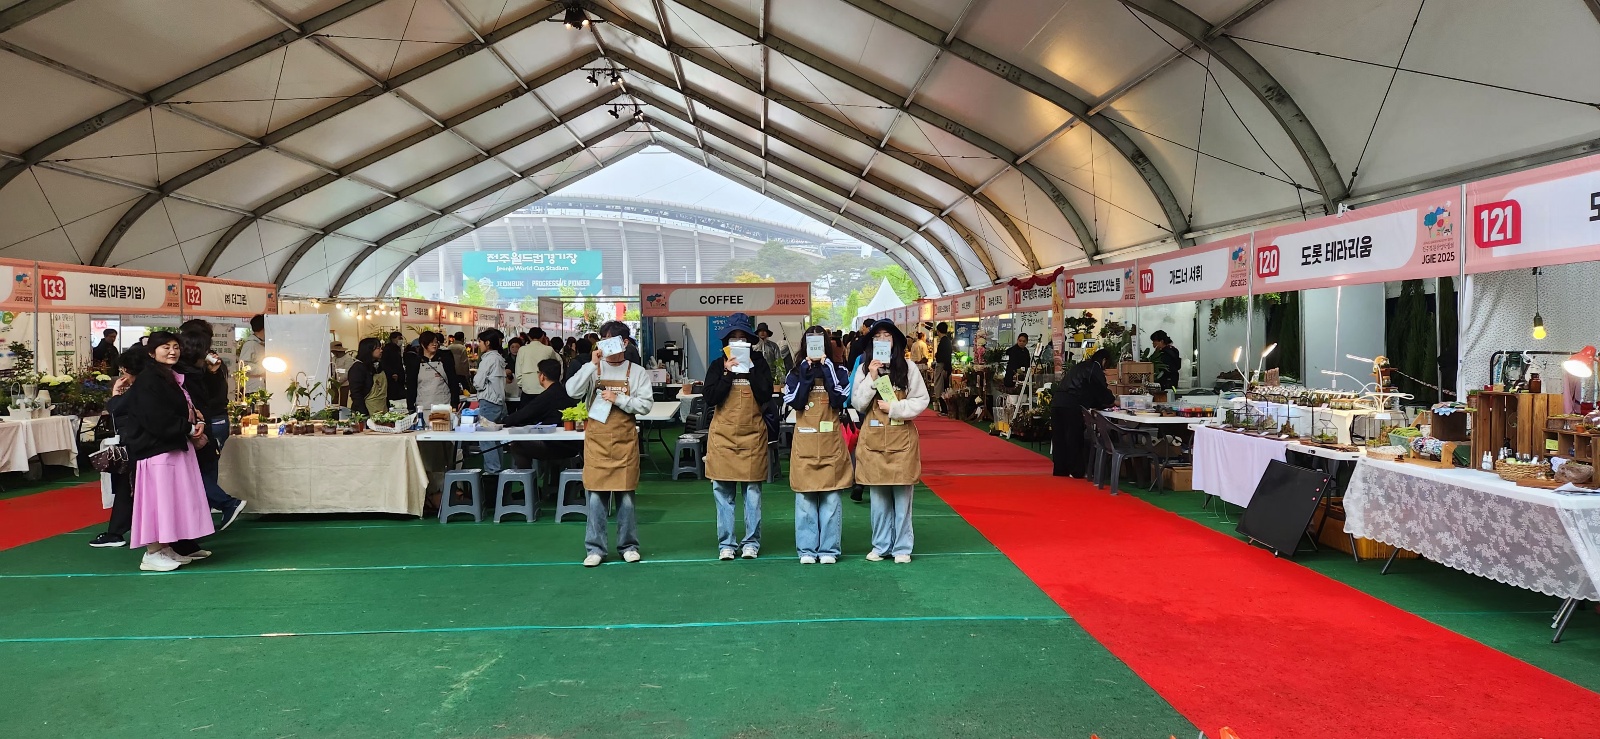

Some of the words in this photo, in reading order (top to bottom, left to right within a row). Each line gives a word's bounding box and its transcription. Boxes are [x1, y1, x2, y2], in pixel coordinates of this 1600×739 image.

[1480, 205, 1513, 243] 121
[1325, 235, 1373, 262] 테라리움
[486, 251, 578, 265] 전주월드컵경기장
[1259, 250, 1277, 275] 120
[1421, 253, 1437, 265] JGIE
[1438, 252, 1455, 263] 2025
[531, 278, 567, 287] PROGRESSIVE
[568, 279, 590, 287] PIONEER
[1141, 273, 1152, 291] 119
[1169, 267, 1188, 285] 가드너
[1188, 264, 1203, 282] 서휘
[43, 278, 64, 298] 133
[89, 283, 146, 300] 채움(마을기업)
[186, 288, 201, 304] 132
[231, 293, 247, 305] 더그린
[699, 295, 744, 305] COFFEE
